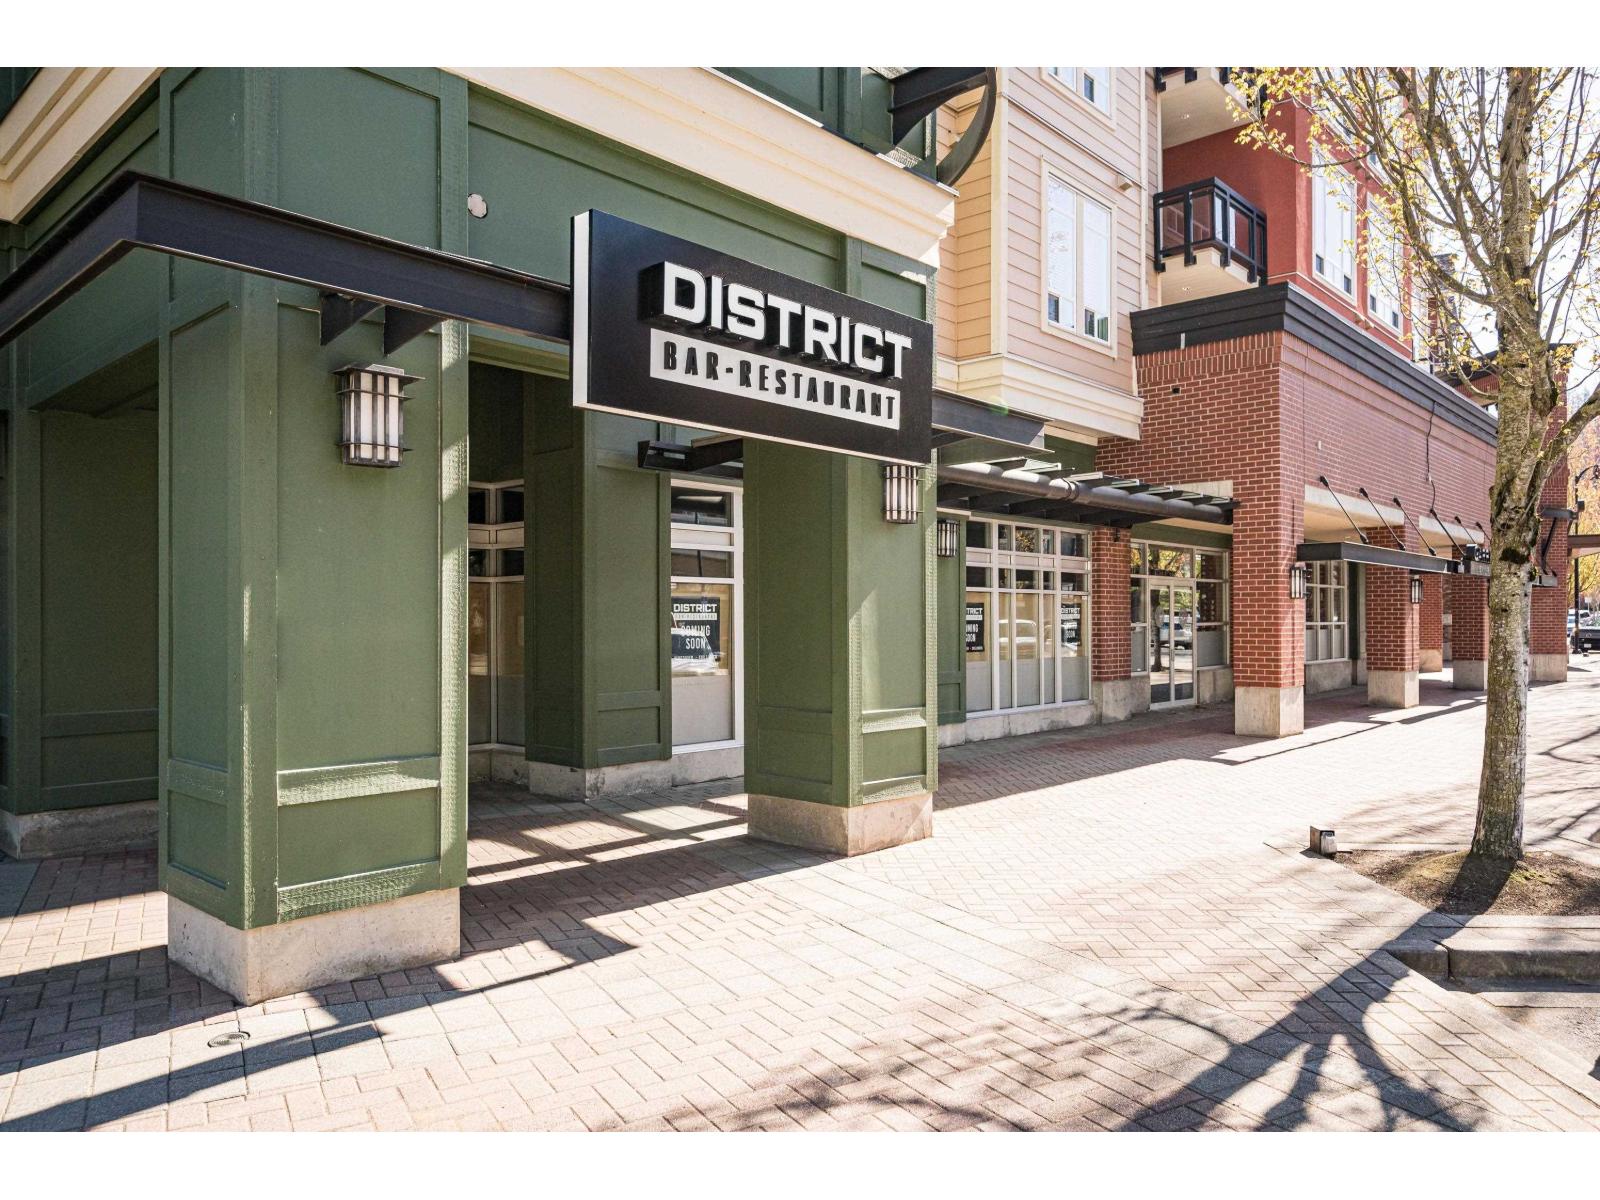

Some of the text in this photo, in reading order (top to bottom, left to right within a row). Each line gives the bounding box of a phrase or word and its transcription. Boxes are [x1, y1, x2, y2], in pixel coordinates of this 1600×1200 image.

[664, 261, 912, 379] DISTRICT
[664, 341, 896, 419] BAR-RESTAURANT
[673, 603, 717, 612] DISTRICT
[966, 607, 983, 615] TRICT
[685, 638, 706, 649] SOON
